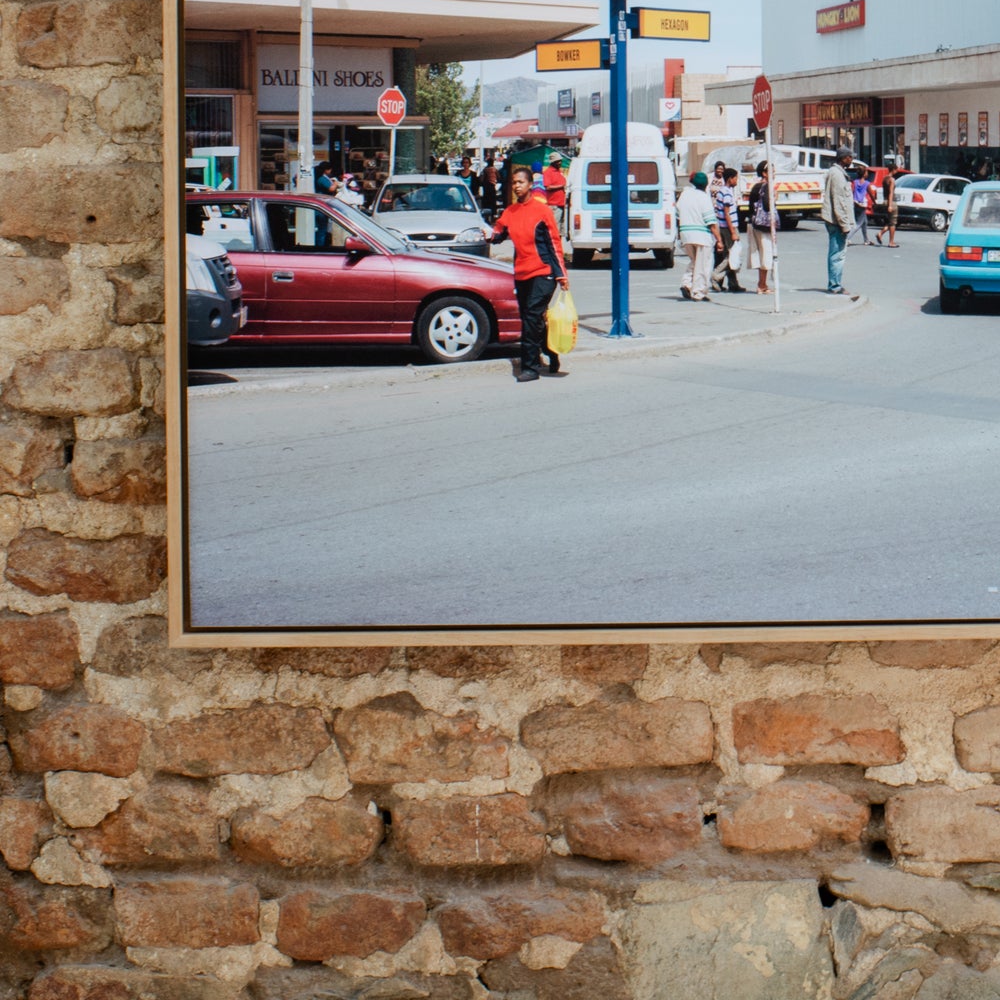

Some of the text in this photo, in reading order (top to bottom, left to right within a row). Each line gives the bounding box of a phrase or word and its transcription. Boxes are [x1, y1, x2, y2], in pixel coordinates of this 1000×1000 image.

[660, 18, 689, 31] HEXAGON
[556, 49, 581, 62] BOWKER
[333, 69, 385, 88] SHOES
[381, 99, 405, 115] STOP
[753, 90, 770, 115] STOP
